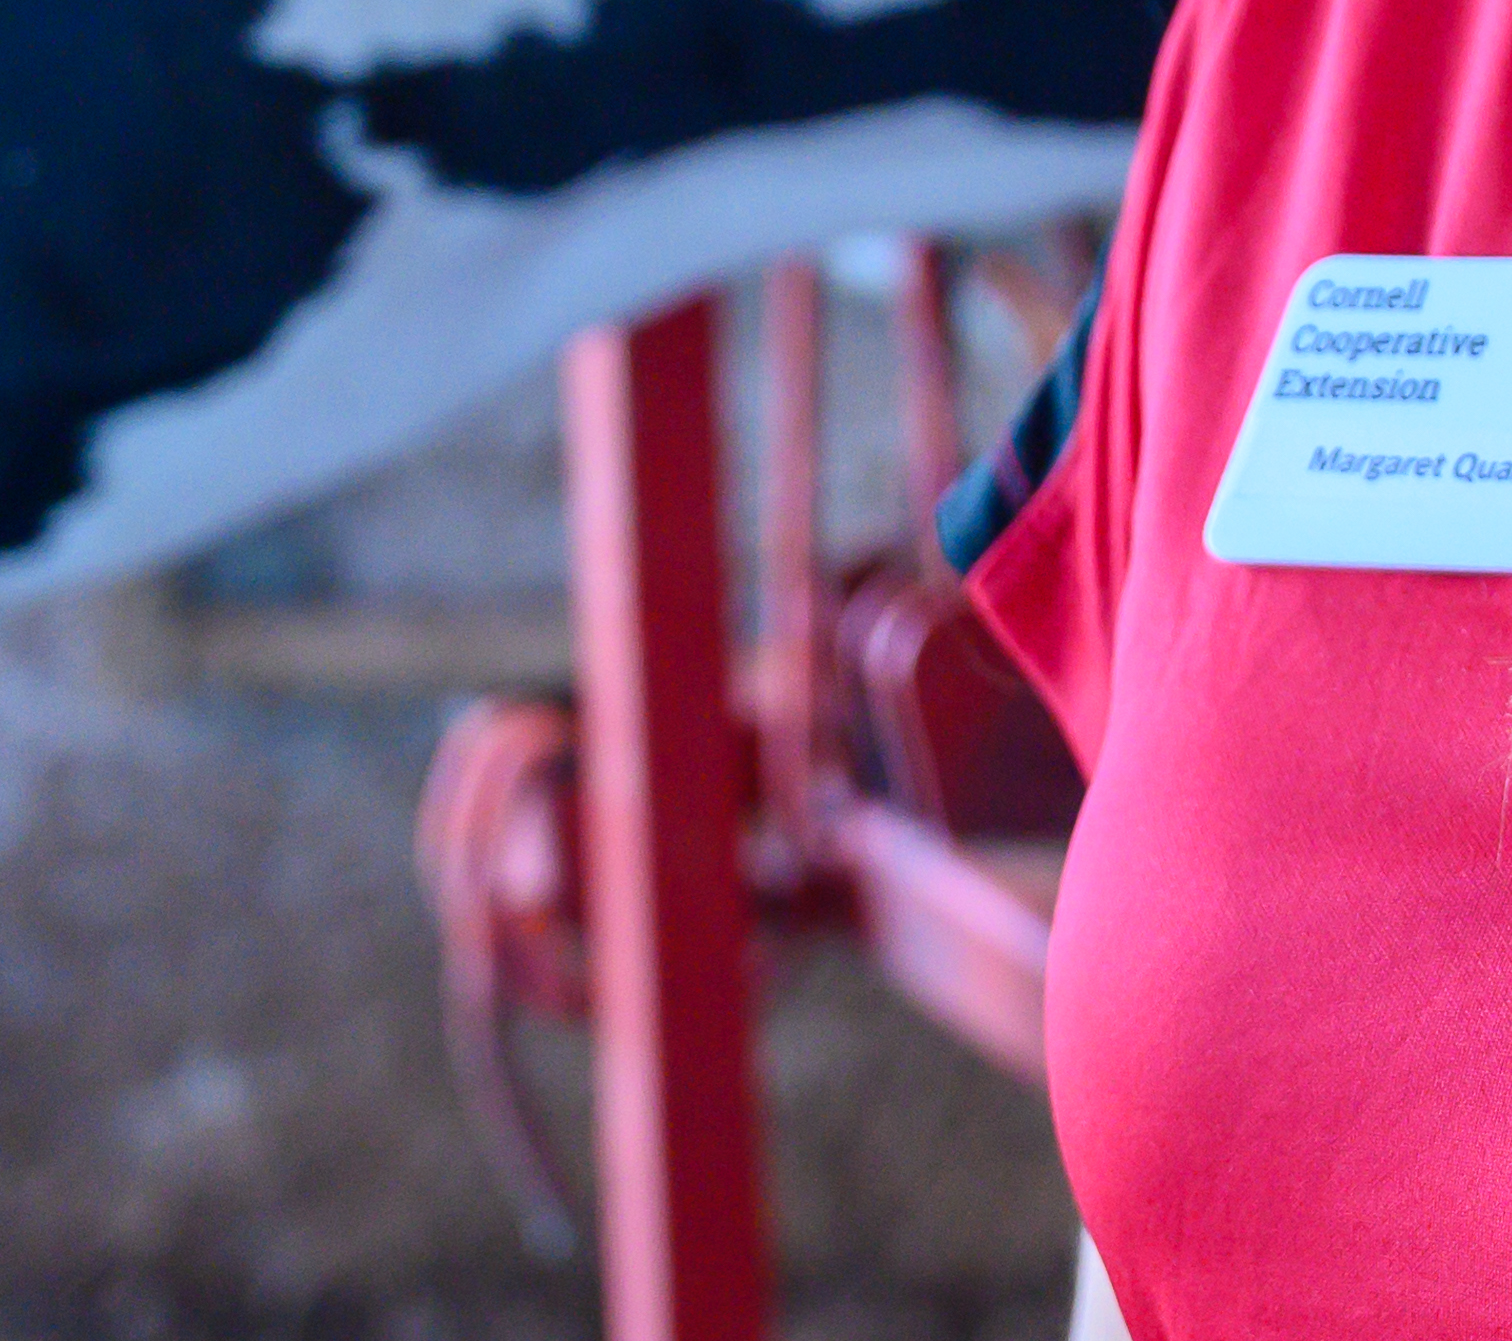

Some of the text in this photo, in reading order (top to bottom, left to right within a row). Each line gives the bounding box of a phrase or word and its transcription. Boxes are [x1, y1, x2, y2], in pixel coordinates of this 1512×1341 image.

[1308, 278, 1430, 309] Cornell
[1292, 323, 1488, 362] Cooperative
[1274, 369, 1440, 401] Extension
[1309, 445, 1446, 481] Margaret
